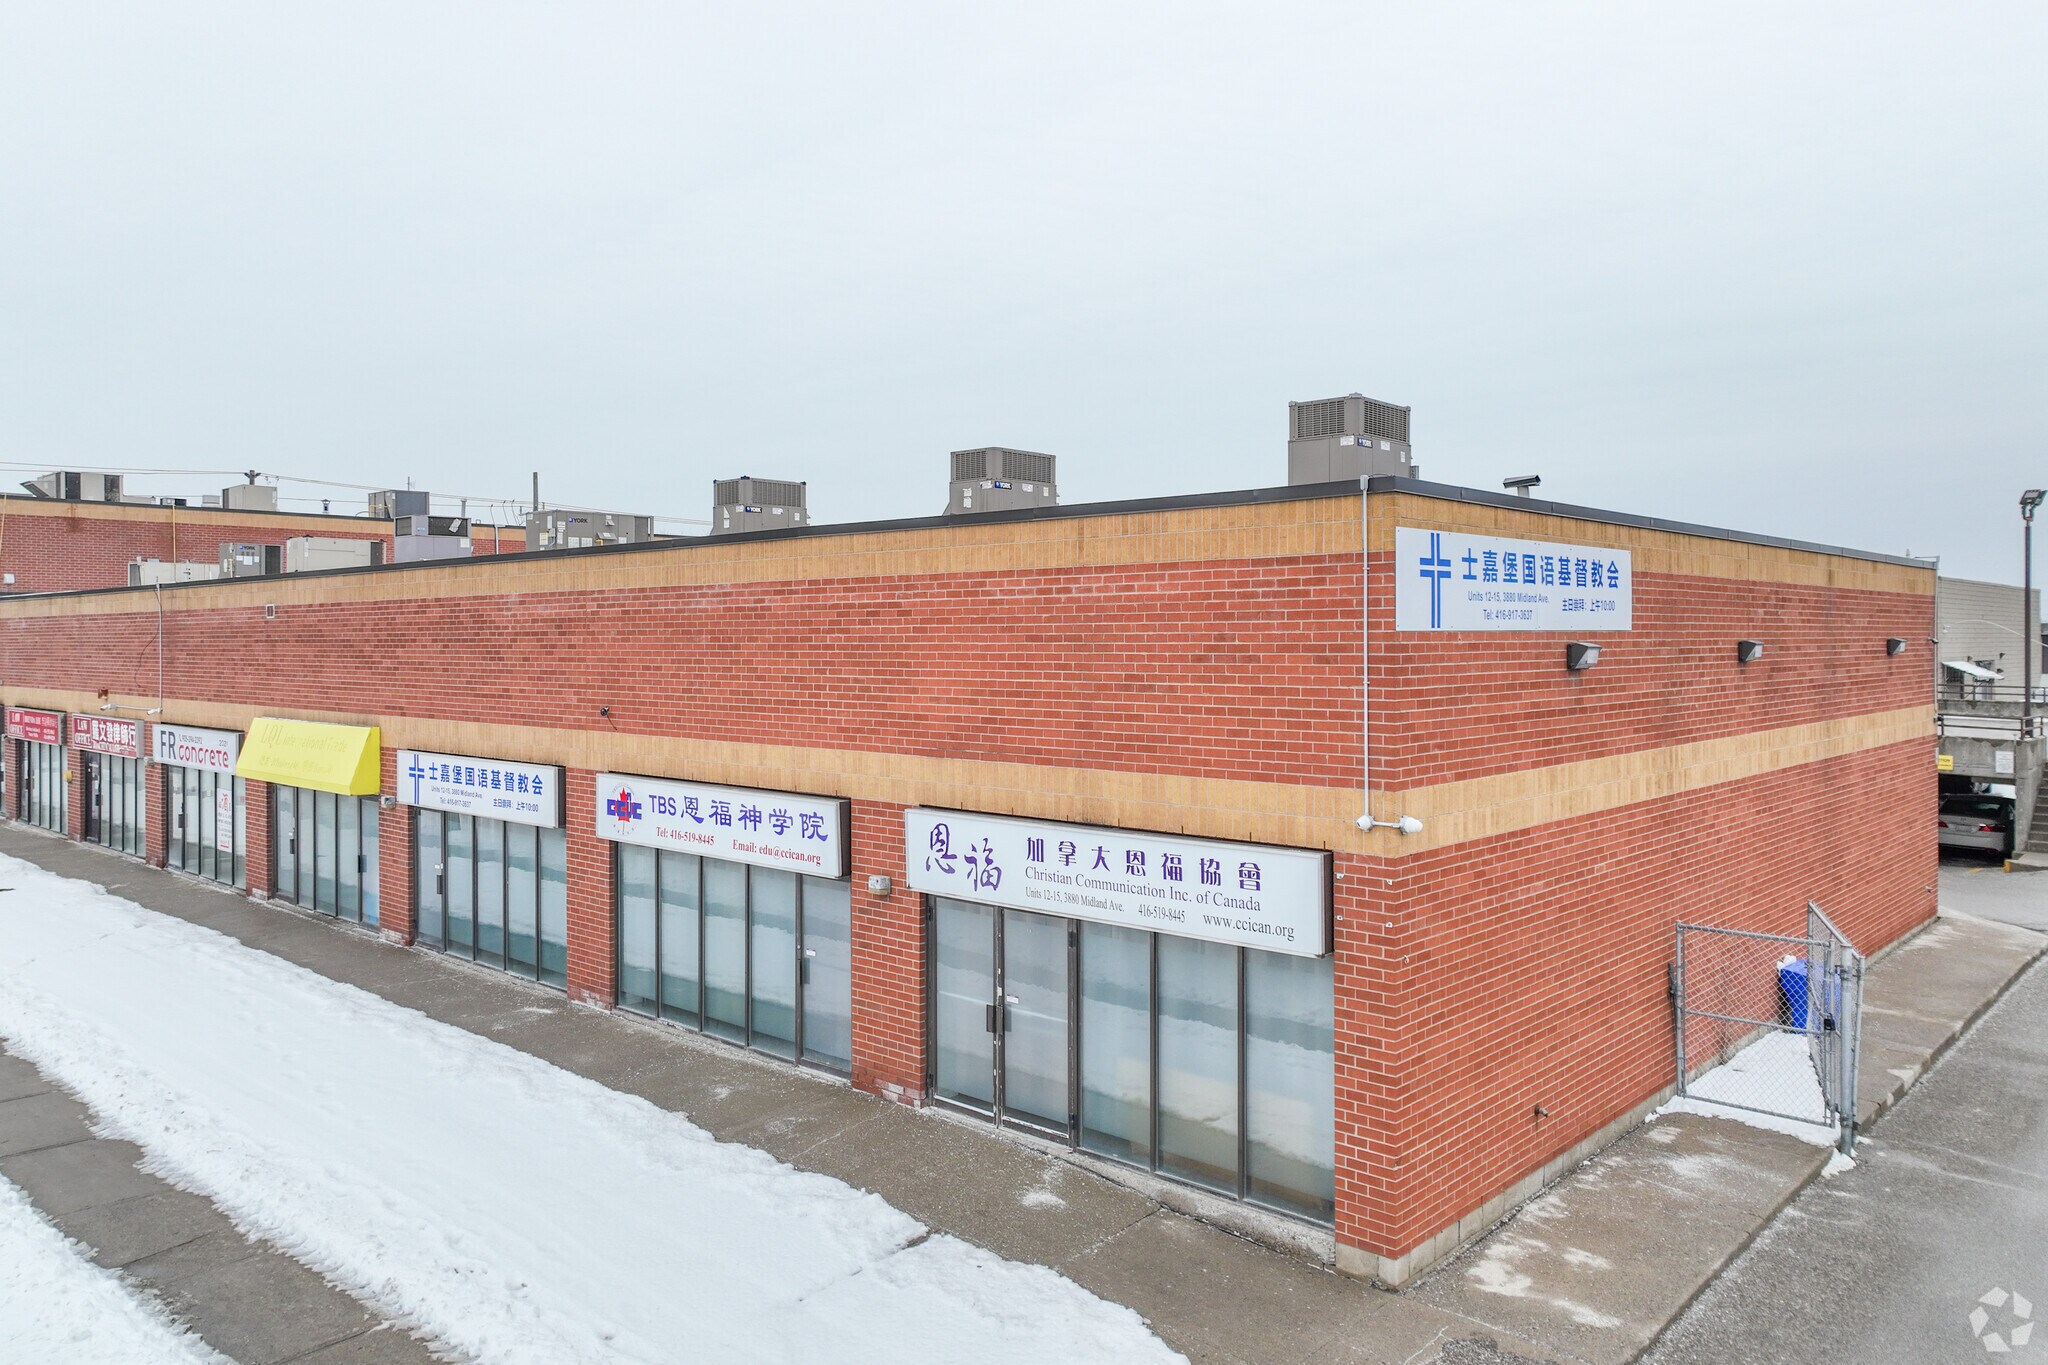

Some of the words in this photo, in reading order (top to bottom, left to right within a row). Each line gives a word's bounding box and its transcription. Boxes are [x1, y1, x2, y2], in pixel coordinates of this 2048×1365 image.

[1461, 548, 1619, 588] 士嘉堡国语基督教会
[1468, 591, 1483, 601] Units
[1517, 593, 1537, 603] Midland
[1538, 593, 1549, 603] Ave.
[1483, 609, 1494, 620] Tel:
[160, 730, 177, 760] FR
[429, 762, 543, 796] 士嘉堡国语基督教会
[656, 826, 668, 838] Tel:
[670, 829, 715, 846] 416-519-8445
[732, 839, 757, 853] Email:
[759, 847, 821, 867] edu@ccican.org
[1026, 837, 1261, 891] 加拿大恩福協會
[1025, 866, 1072, 885] Christian
[1075, 874, 1166, 899] Communication
[1170, 886, 1192, 903] Inc.
[1196, 890, 1210, 905] of
[1213, 892, 1261, 912] Canada
[1025, 886, 1042, 899] Units
[1043, 889, 1063, 903] 12-15,
[1064, 891, 1080, 905] 3880
[1080, 894, 1108, 909] Midland
[1109, 898, 1125, 912] Ave.
[1138, 903, 1186, 923] 416-519-8445
[1203, 914, 1295, 942] www.ccican.org
